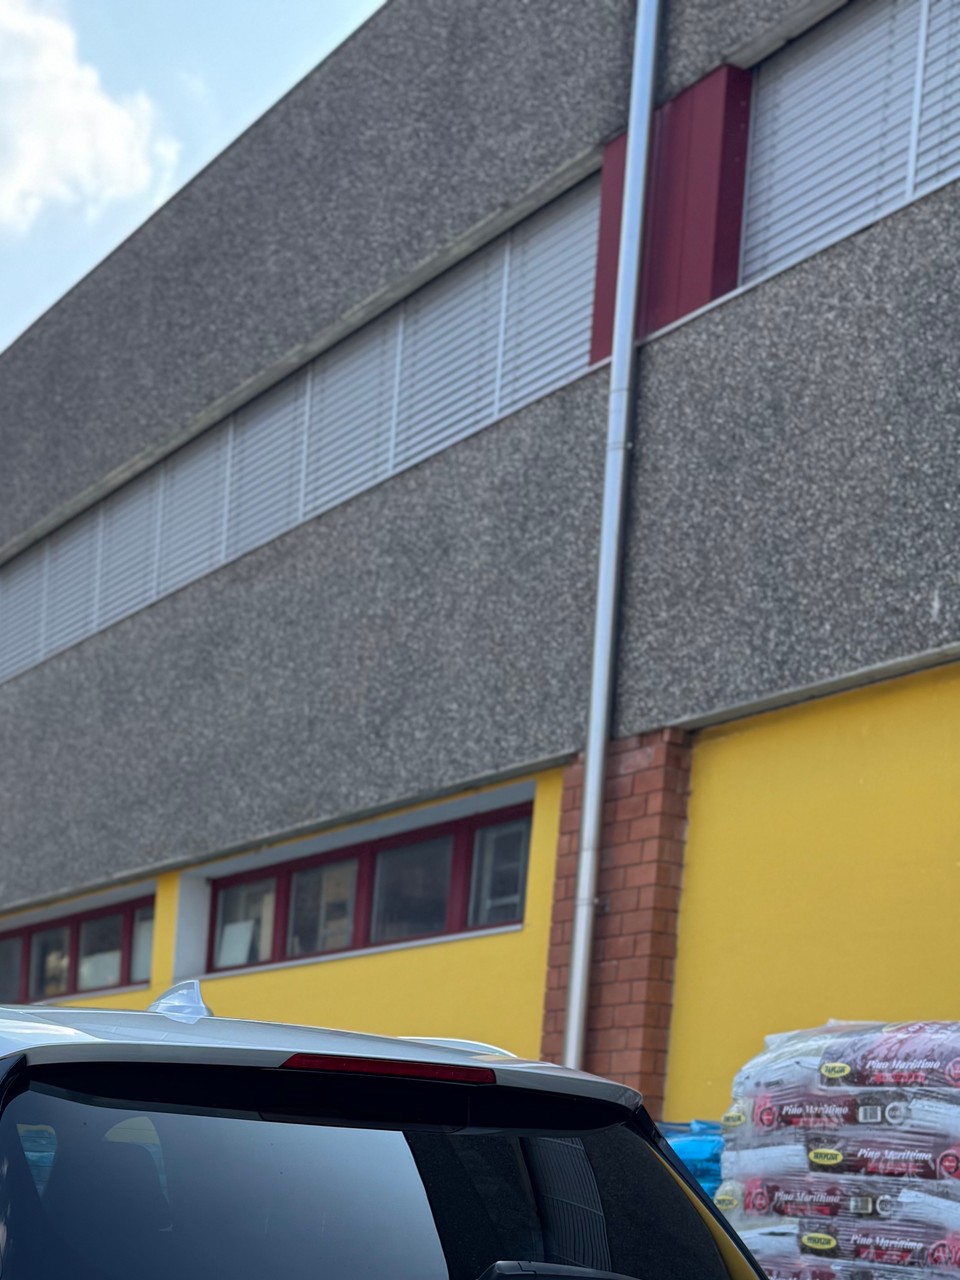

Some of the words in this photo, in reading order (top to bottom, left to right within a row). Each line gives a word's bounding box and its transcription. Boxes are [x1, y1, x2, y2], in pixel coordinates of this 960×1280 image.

[782, 1104, 803, 1115] Pino
[857, 1148, 880, 1159] Pino
[774, 1191, 794, 1202] Pino
[850, 1233, 872, 1245] Pino
